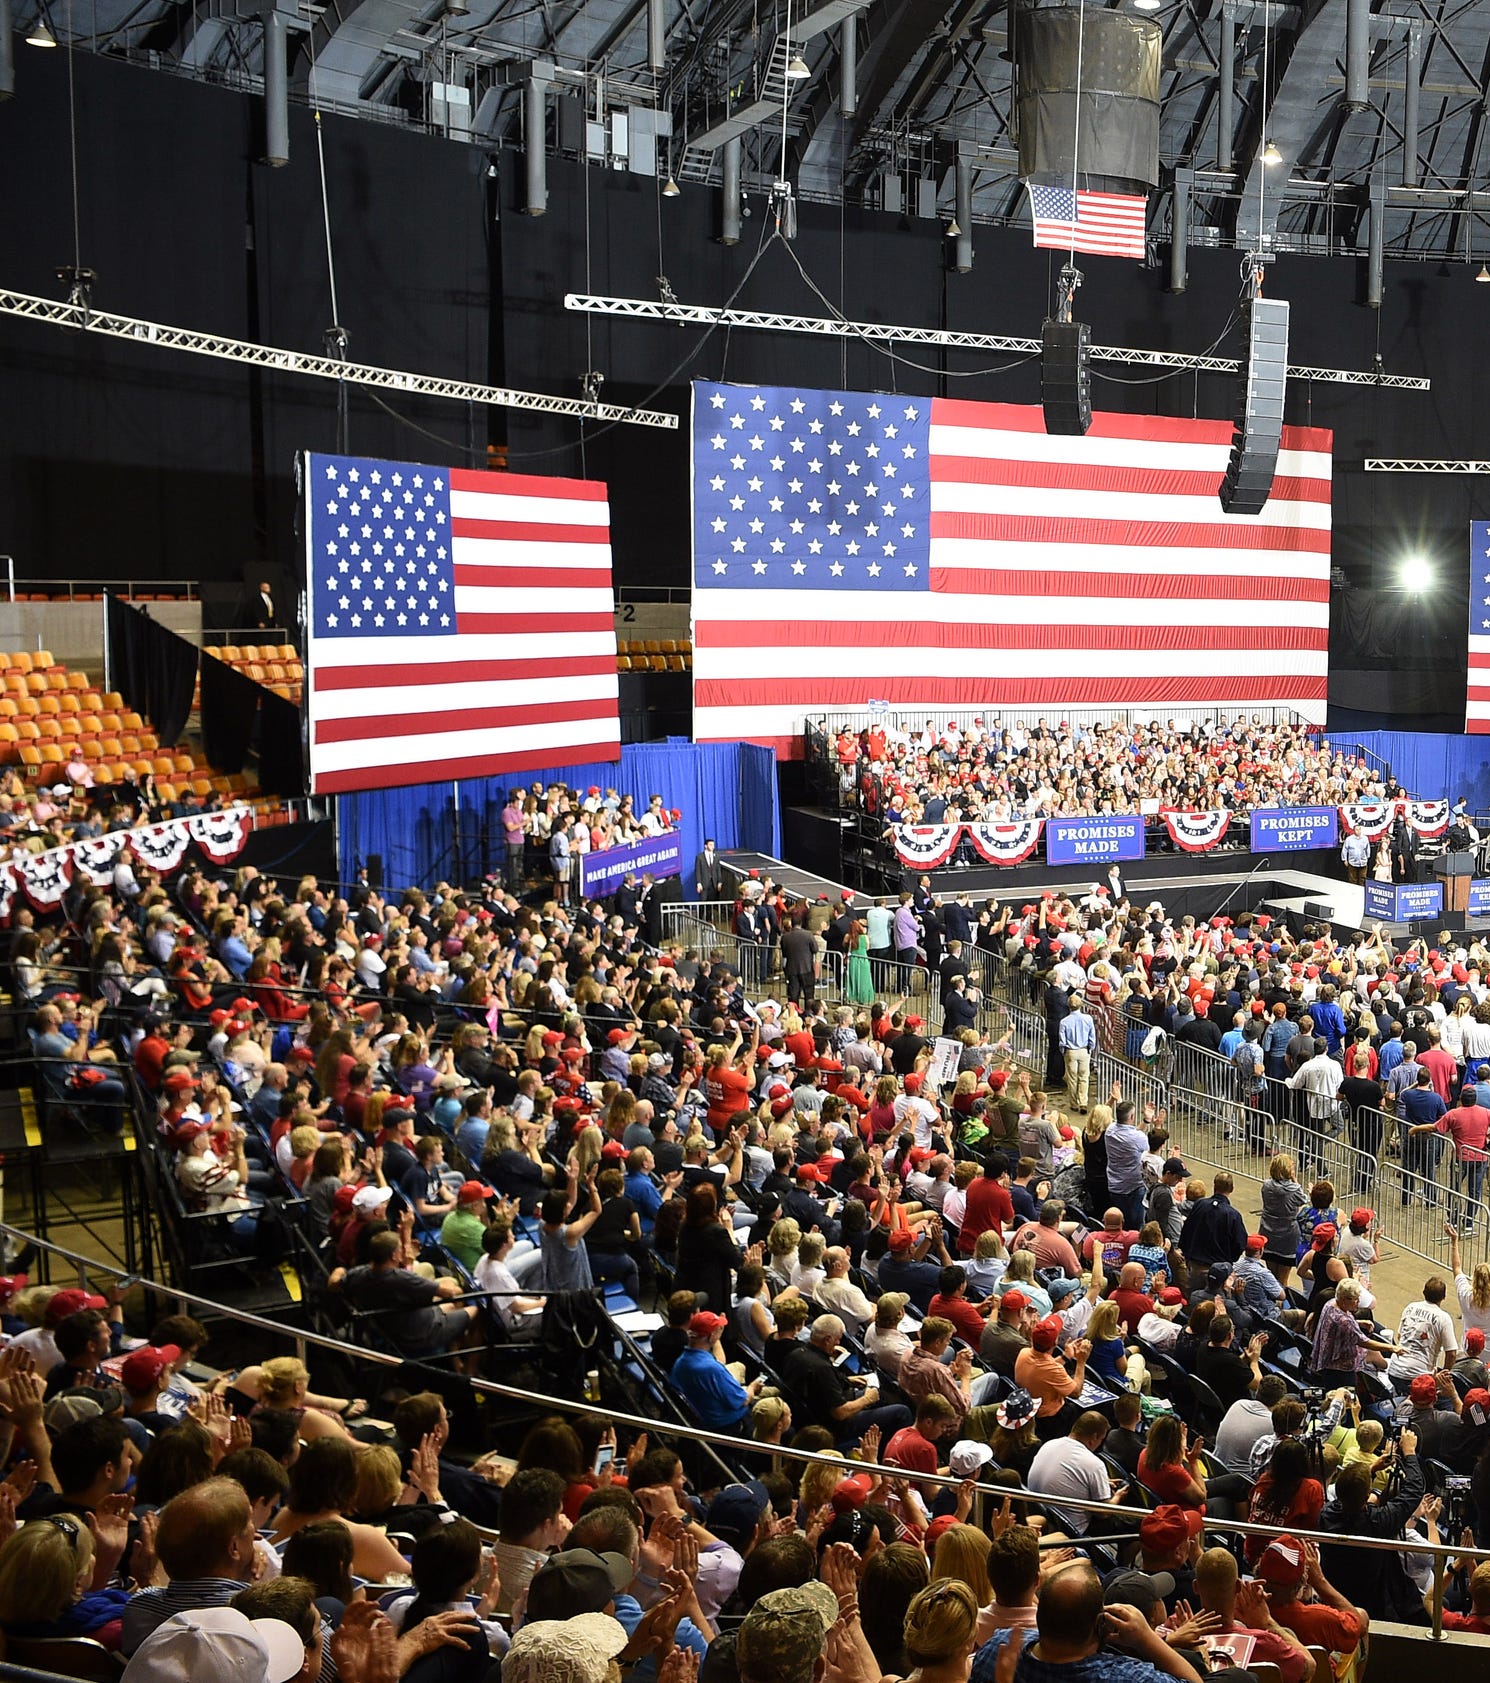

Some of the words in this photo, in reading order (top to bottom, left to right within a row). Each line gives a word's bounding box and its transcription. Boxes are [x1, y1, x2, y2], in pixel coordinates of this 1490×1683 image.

[1260, 815, 1330, 830] PROMISES
[1057, 825, 1136, 841] PROMISES
[1278, 829, 1314, 843] KEPT
[1074, 840, 1119, 854] MADE
[586, 867, 607, 883] MAKE
[607, 859, 637, 878] AMERICA
[636, 853, 657, 868] GREAT
[657, 847, 678, 862] AGAIN!
[1367, 886, 1394, 899] PROMISES
[1401, 889, 1439, 899] PROMISES
[1408, 897, 1431, 906] MADE
